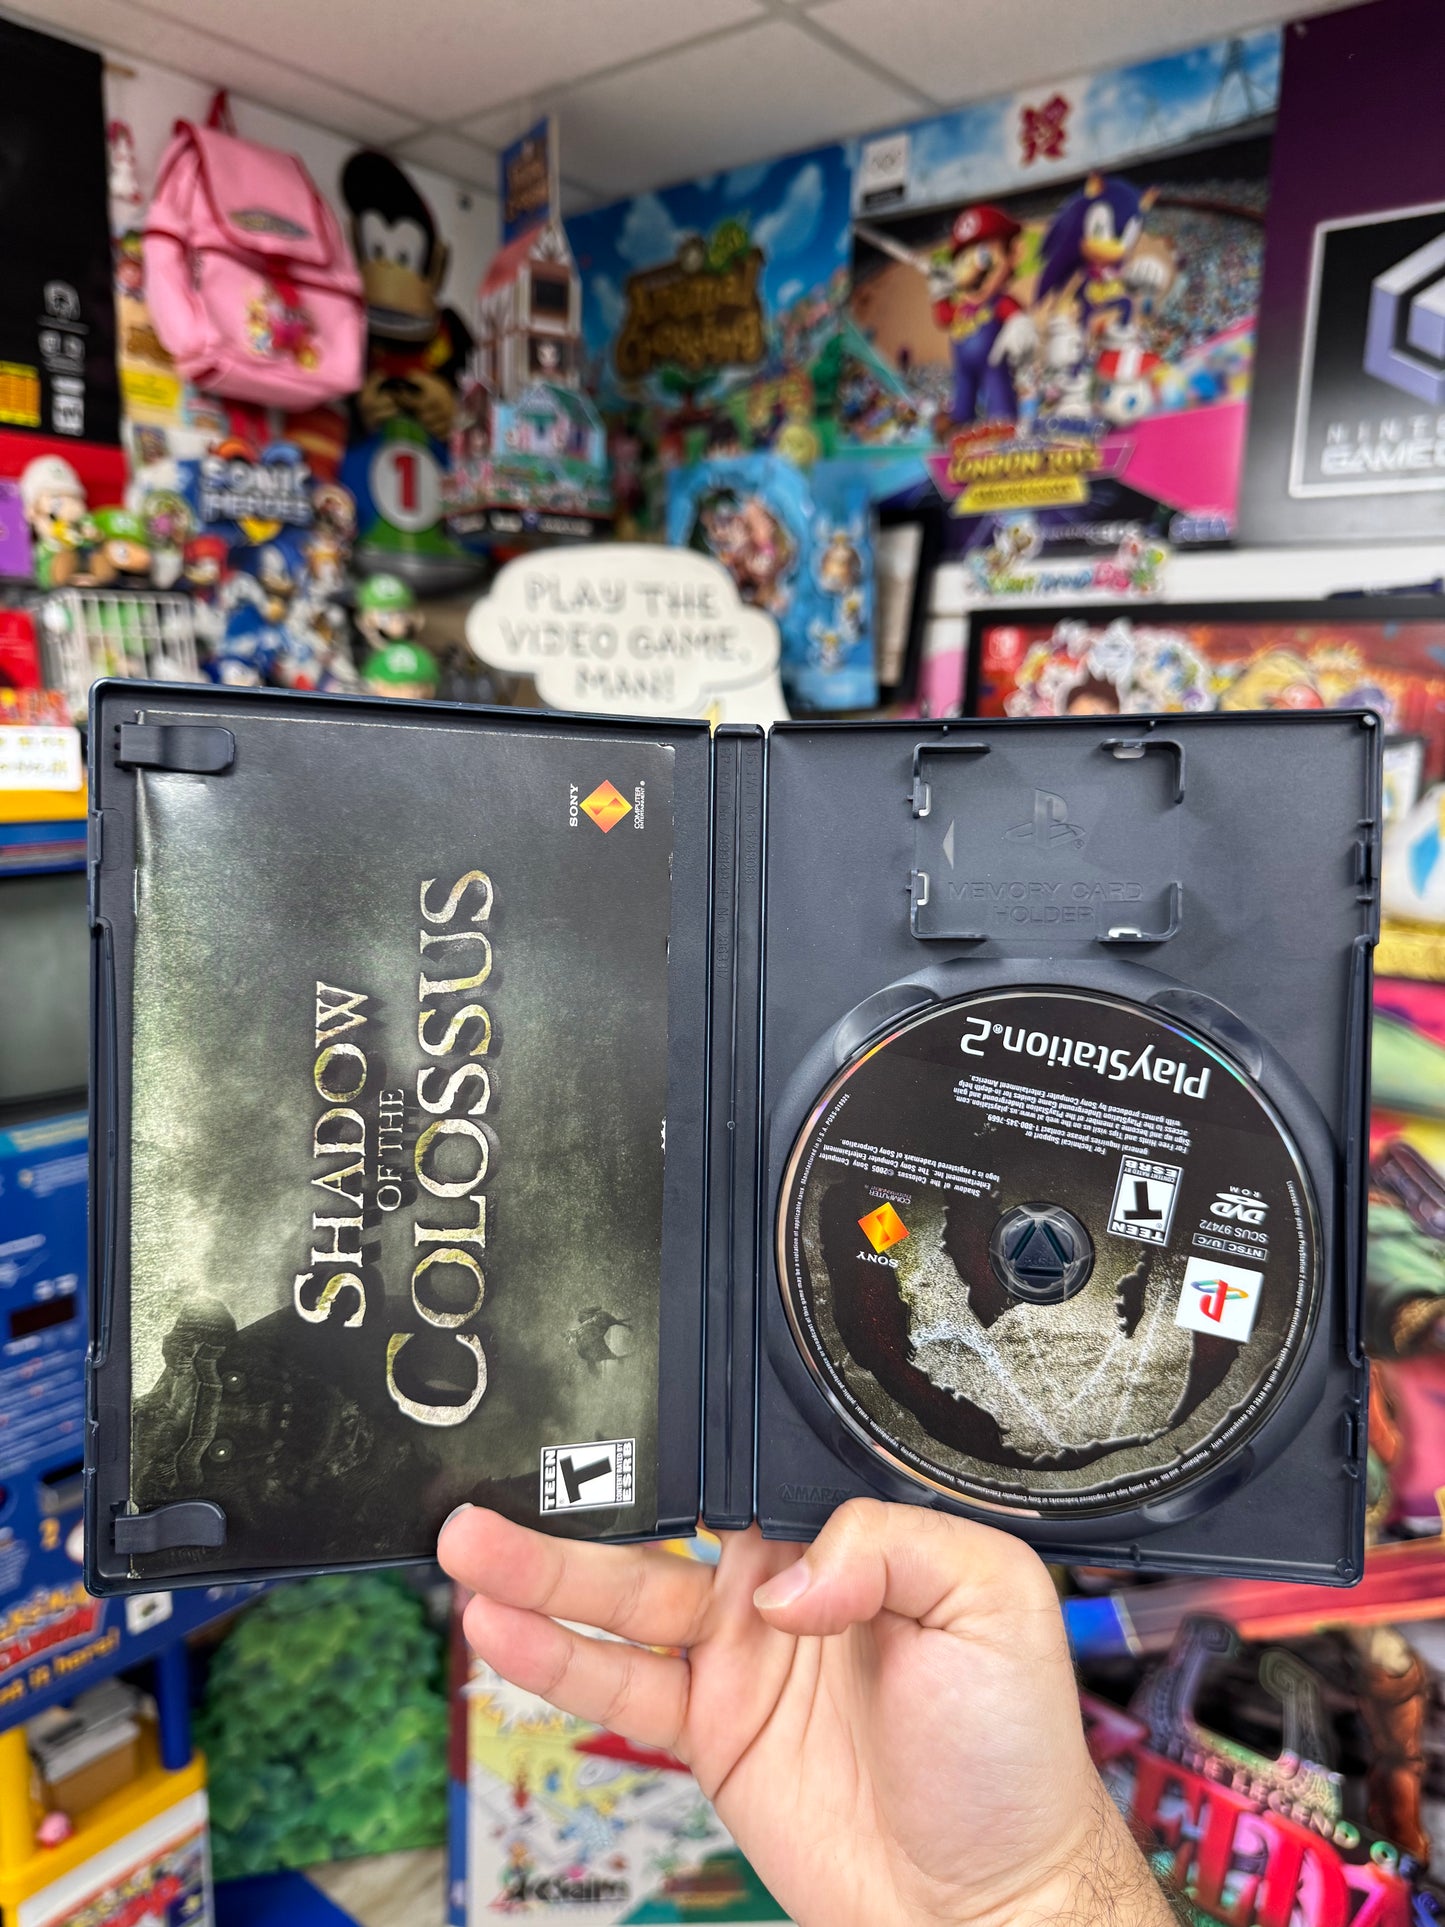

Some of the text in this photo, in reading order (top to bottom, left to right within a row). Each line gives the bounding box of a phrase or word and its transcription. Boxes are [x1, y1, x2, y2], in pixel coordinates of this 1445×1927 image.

[394, 455, 418, 512] 1
[524, 573, 718, 618] PLAY THE
[500, 617, 618, 659] VIDEO
[569, 783, 577, 826] SONY
[947, 880, 1143, 901] MEMORY CARD
[993, 905, 1095, 924] HOLDER
[952, 1085, 968, 1095] gain
[968, 1090, 981, 1098] and
[952, 1093, 1036, 1119] www.us.playstation.com.
[957, 1078, 1188, 1136] access to the PlayStation Underground Game Guides for in-depth help
[968, 1074, 1181, 1127] with games produced by Sony Computer Entertainment America.
[982, 1091, 1025, 1108] Underground
[1025, 1101, 1064, 1117] PlayStation
[1036, 1113, 1044, 1121] at
[1064, 1111, 1076, 1120] the
[1044, 1115, 1059, 1124] web
[1060, 1119, 1072, 1127] the
[1085, 1116, 1113, 1128] member
[1033, 1131, 1060, 1144] Support
[1091, 1126, 1107, 1135] visit
[1107, 1128, 1124, 1139] Tips
[1120, 1124, 1148, 1136] become
[1123, 1133, 1137, 1142] and
[1149, 1130, 1162, 1139] and
[1163, 1132, 1173, 1140] up
[838, 1136, 878, 1153] Corporation.
[1060, 1138, 1093, 1151] Technical
[1137, 1136, 1156, 1146] Hints
[1157, 1140, 1174, 1150] Free
[1173, 1134, 1190, 1145] Sign
[294, 980, 369, 1328] SHADOW
[377, 1088, 406, 1211] OF THE
[385, 870, 495, 1426] COLOSSUS
[878, 1146, 895, 1157] Sony
[895, 1151, 902, 1159] of
[1093, 1145, 1106, 1154] For
[1174, 1144, 1187, 1153] For
[823, 1143, 991, 1189] Entertainment Inc. The Sony Computer Entertainment
[903, 1153, 936, 1167] trademark
[937, 1160, 971, 1175] registered
[1124, 1158, 1177, 1177] ESRB
[818, 1151, 981, 1197] Shadow of the Colossus ©2005 Sony Computer
[984, 1171, 1000, 1182] logo
[868, 1189, 911, 1204] COMPUTER
[1228, 1185, 1262, 1199] ROM
[1125, 1181, 1162, 1220] T
[1208, 1197, 1266, 1226] DVD
[1111, 1220, 1164, 1241] TEEN
[1198, 1218, 1267, 1243] SCUS 97472
[1197, 1236, 1262, 1259] NTSC U/C
[855, 1250, 899, 1268] SONY
[1252, 1390, 1266, 1406] NTSC
[559, 1455, 612, 1504] T
[622, 1441, 632, 1502] ESRB
[543, 1450, 557, 1510] TEEN
